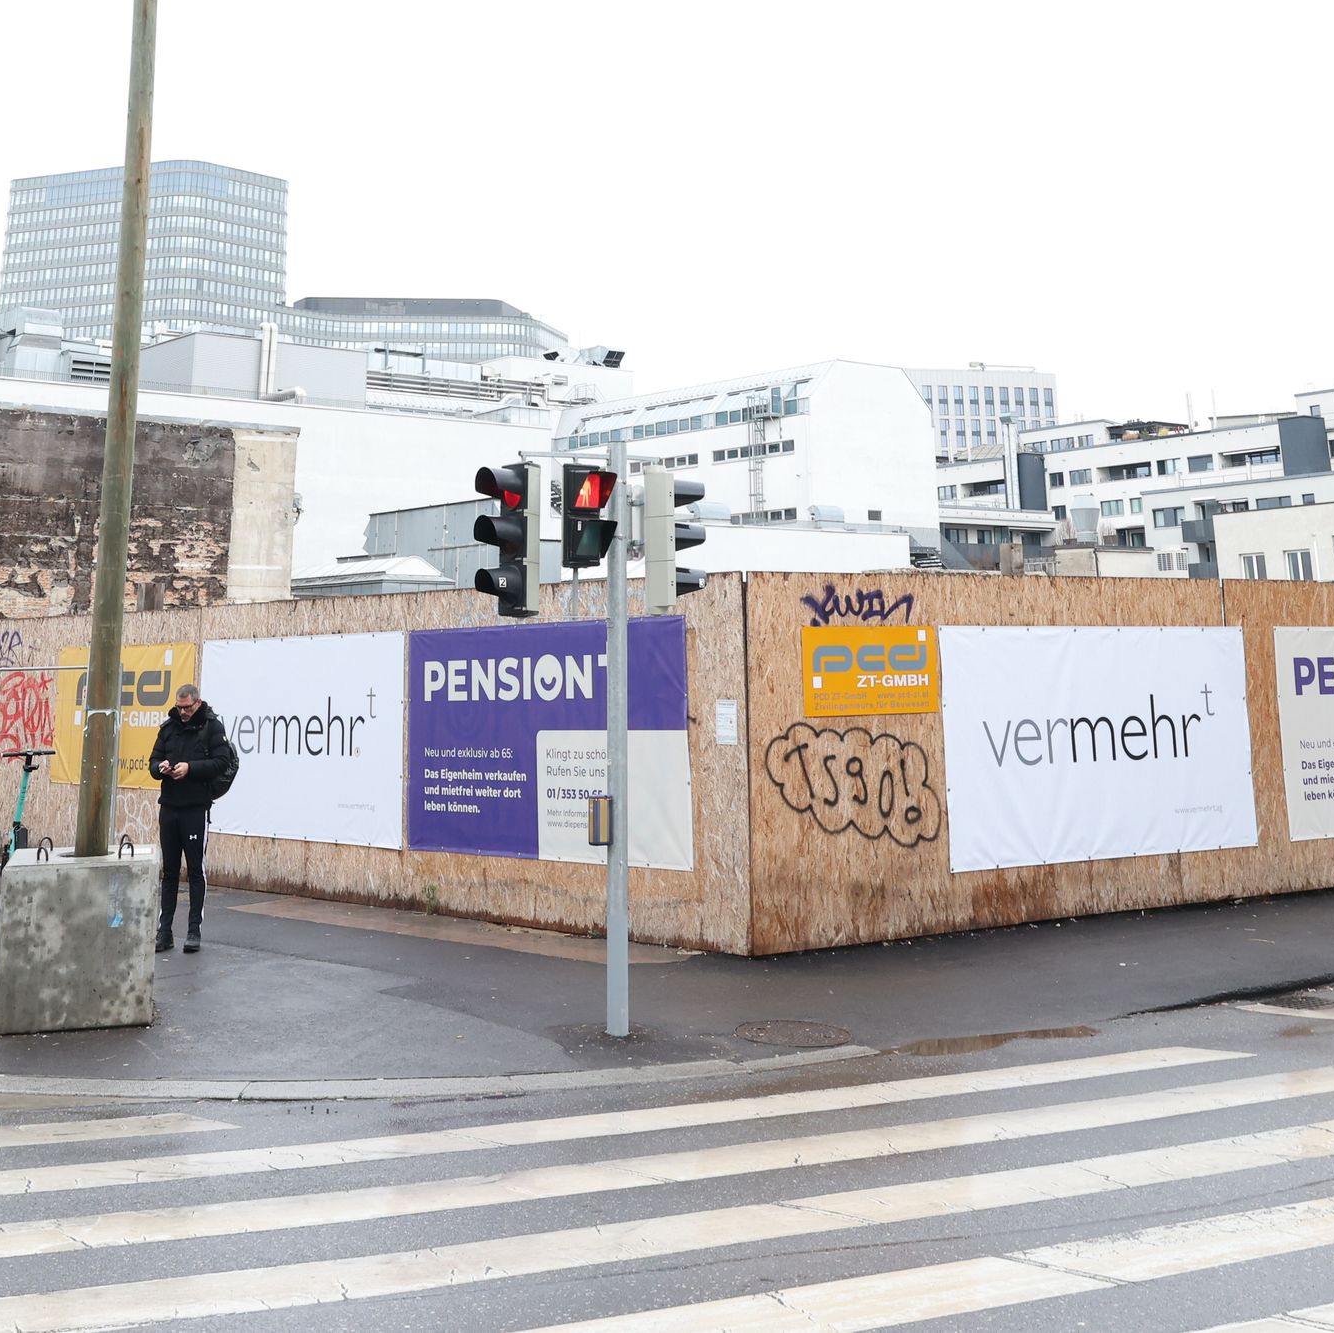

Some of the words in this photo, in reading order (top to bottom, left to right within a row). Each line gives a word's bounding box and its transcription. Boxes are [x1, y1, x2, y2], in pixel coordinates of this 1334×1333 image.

[500, 578, 506, 586] 2
[856, 674, 929, 688] ZT-GMBH
[1299, 739, 1315, 749] Neu
[1316, 738, 1331, 748] und
[424, 747, 440, 758] Neu
[441, 747, 456, 758] und
[457, 747, 488, 759] exklusiv
[489, 748, 500, 759] ab
[501, 748, 513, 759] 65:
[546, 748, 571, 762] Klingt
[573, 751, 584, 760] zu
[585, 748, 607, 760] schö
[546, 764, 572, 777] Rufen
[573, 765, 587, 777] Sie
[589, 768, 605, 778] uns
[1301, 760, 1317, 770] Das
[424, 769, 439, 779] Das
[440, 768, 483, 783] Eigenheim
[485, 770, 527, 782] verkaufen
[1302, 775, 1318, 786] und
[424, 785, 440, 796] und
[441, 785, 474, 797] mietfrei
[475, 787, 501, 798] weiter
[503, 787, 522, 799] dort
[546, 787, 576, 800] 01/353
[578, 789, 590, 800] 50
[1304, 791, 1327, 801] leben
[424, 800, 446, 812] leben
[447, 800, 481, 814] können.
[546, 808, 562, 817] Mehr
[563, 809, 588, 818] Informat
[546, 820, 588, 829] www.diepens
